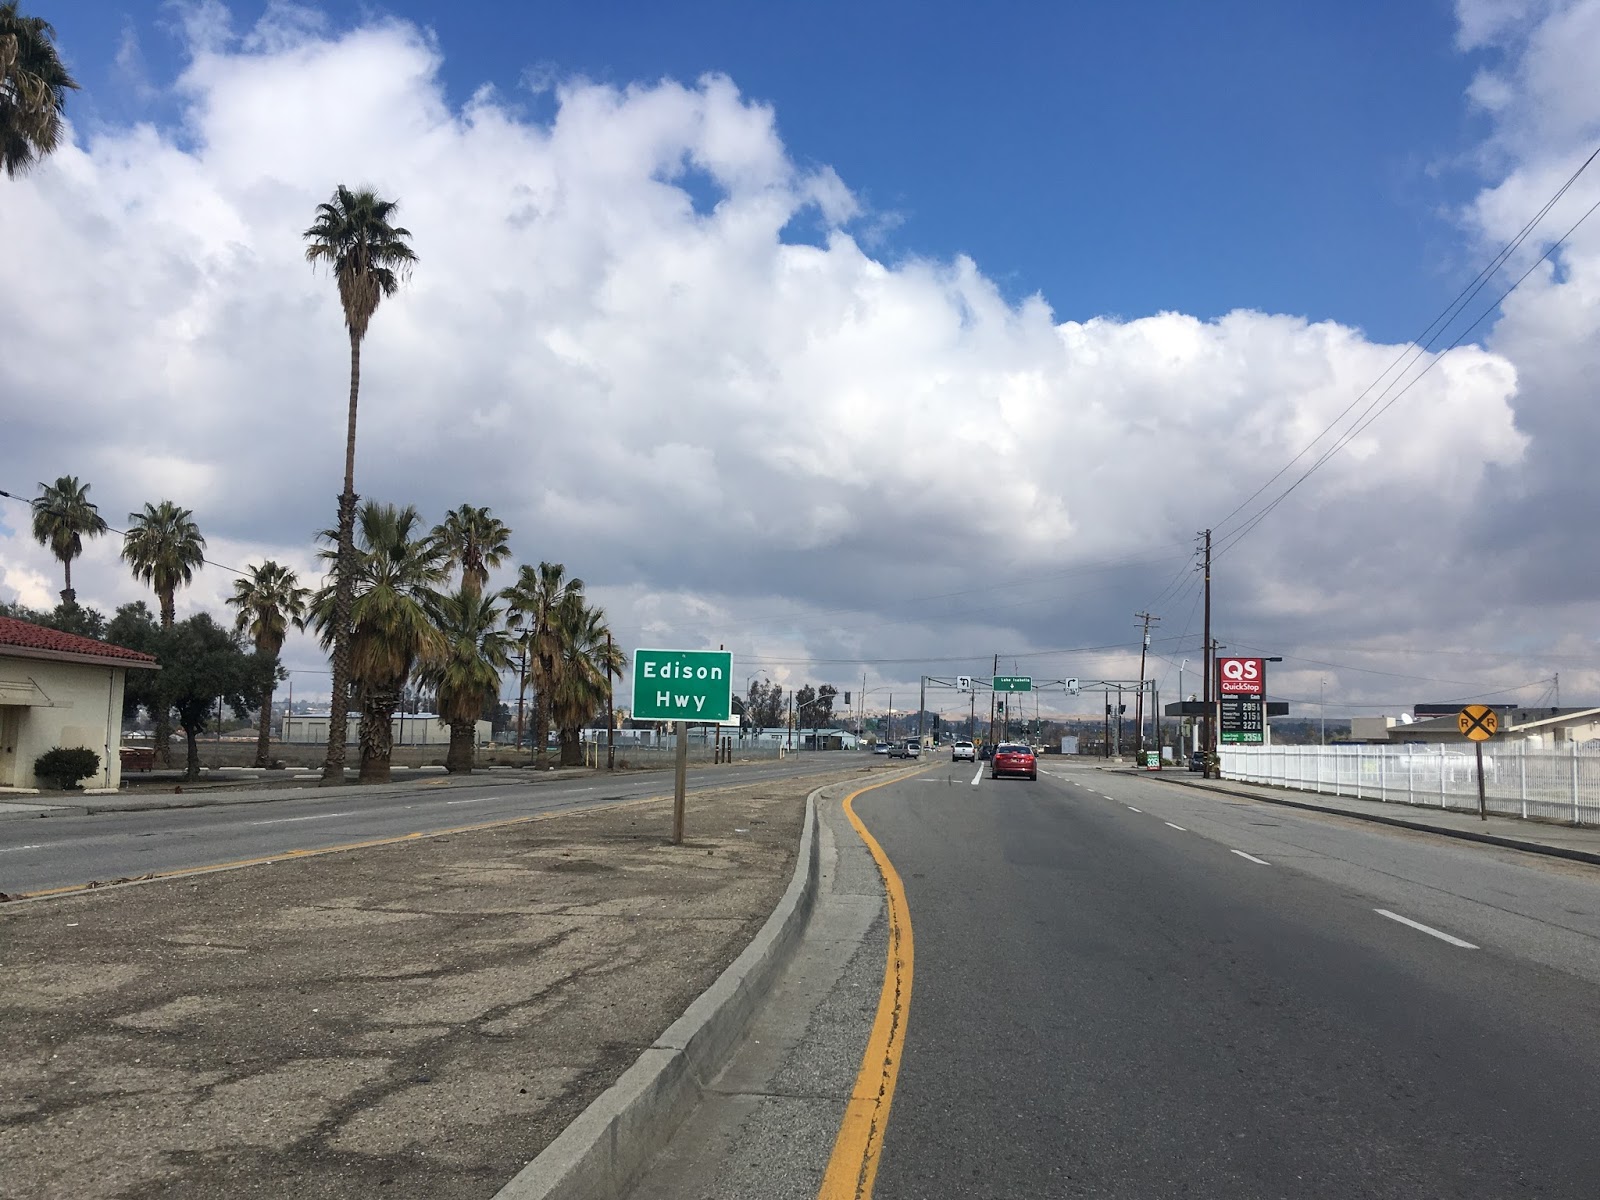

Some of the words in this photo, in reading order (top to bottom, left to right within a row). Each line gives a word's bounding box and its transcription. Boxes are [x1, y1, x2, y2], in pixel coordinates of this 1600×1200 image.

[643, 661, 722, 680] Edison
[1223, 660, 1258, 681] QS
[1222, 682, 1259, 692] QuickStop
[656, 691, 707, 712] Hwy
[1242, 703, 1256, 711] 295
[1242, 712, 1256, 720] 315
[1242, 721, 1256, 729] 327
[1461, 718, 1469, 727] R
[1487, 718, 1495, 727] R
